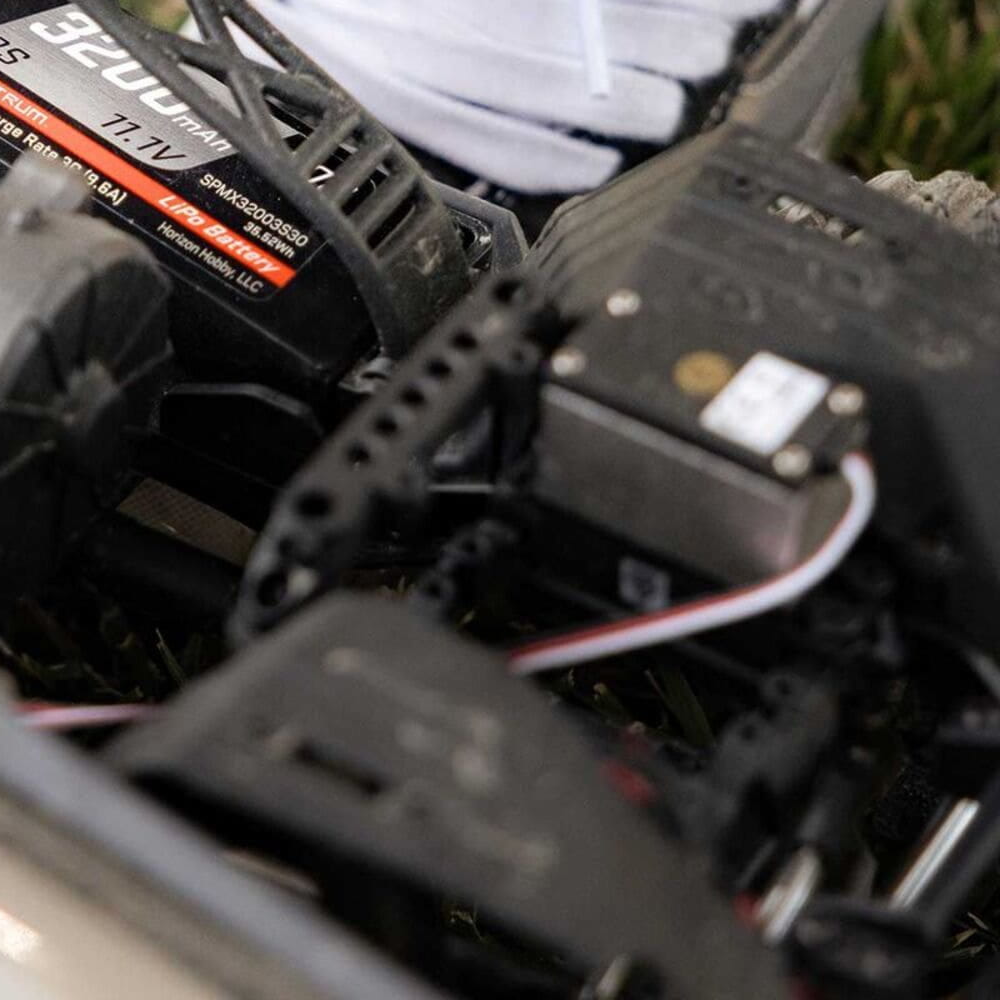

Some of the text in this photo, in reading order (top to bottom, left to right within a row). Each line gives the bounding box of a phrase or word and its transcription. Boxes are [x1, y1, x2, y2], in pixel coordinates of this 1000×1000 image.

[23, 132, 59, 160] Rate
[101, 112, 187, 161] 11.1V
[157, 194, 281, 273] LiPo Battery
[200, 173, 309, 247] SPMX32003S30
[156, 221, 264, 293] Horizon Hobby, LLC
